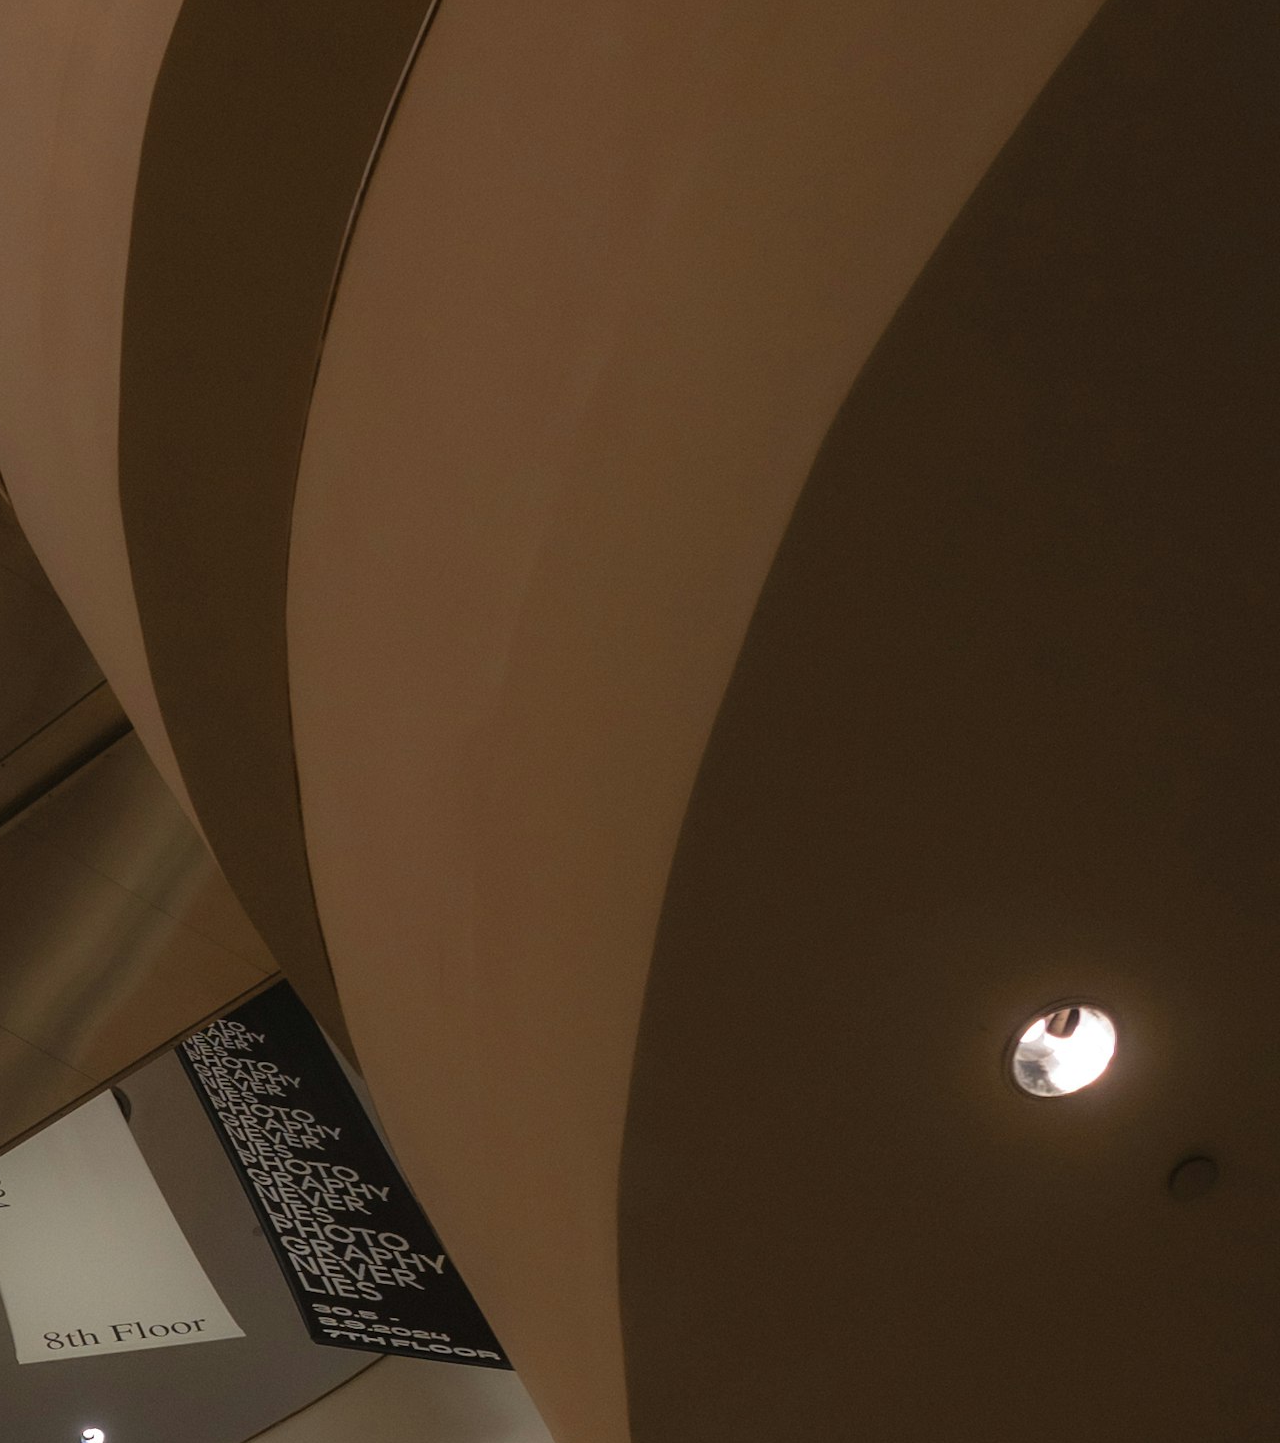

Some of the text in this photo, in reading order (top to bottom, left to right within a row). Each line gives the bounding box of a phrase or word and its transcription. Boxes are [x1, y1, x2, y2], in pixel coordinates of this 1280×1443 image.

[186, 1051, 278, 1074] PHOTO
[193, 1063, 301, 1088] GRAPHY
[198, 1073, 286, 1097] NEVER
[204, 1084, 258, 1104] LIES
[210, 1096, 315, 1123] PHOTO
[218, 1111, 341, 1140] GRAPHY
[223, 1123, 325, 1150] NEVER
[230, 1136, 293, 1158] LIES
[237, 1150, 359, 1182] PHOTO
[247, 1168, 390, 1201] GRAPHY
[253, 1182, 372, 1215] NEVER
[261, 1197, 335, 1223] LIES
[269, 1215, 410, 1251] PHOTO
[280, 1235, 445, 1274] GRAPHY
[288, 1252, 425, 1290] NEVER
[297, 1272, 383, 1301] LIES
[311, 1303, 379, 1320] 30.5
[43, 1318, 206, 1350] 8th Floor
[318, 1316, 451, 1342] 8.9.2024
[323, 1329, 501, 1360] 7TH FLOOR
